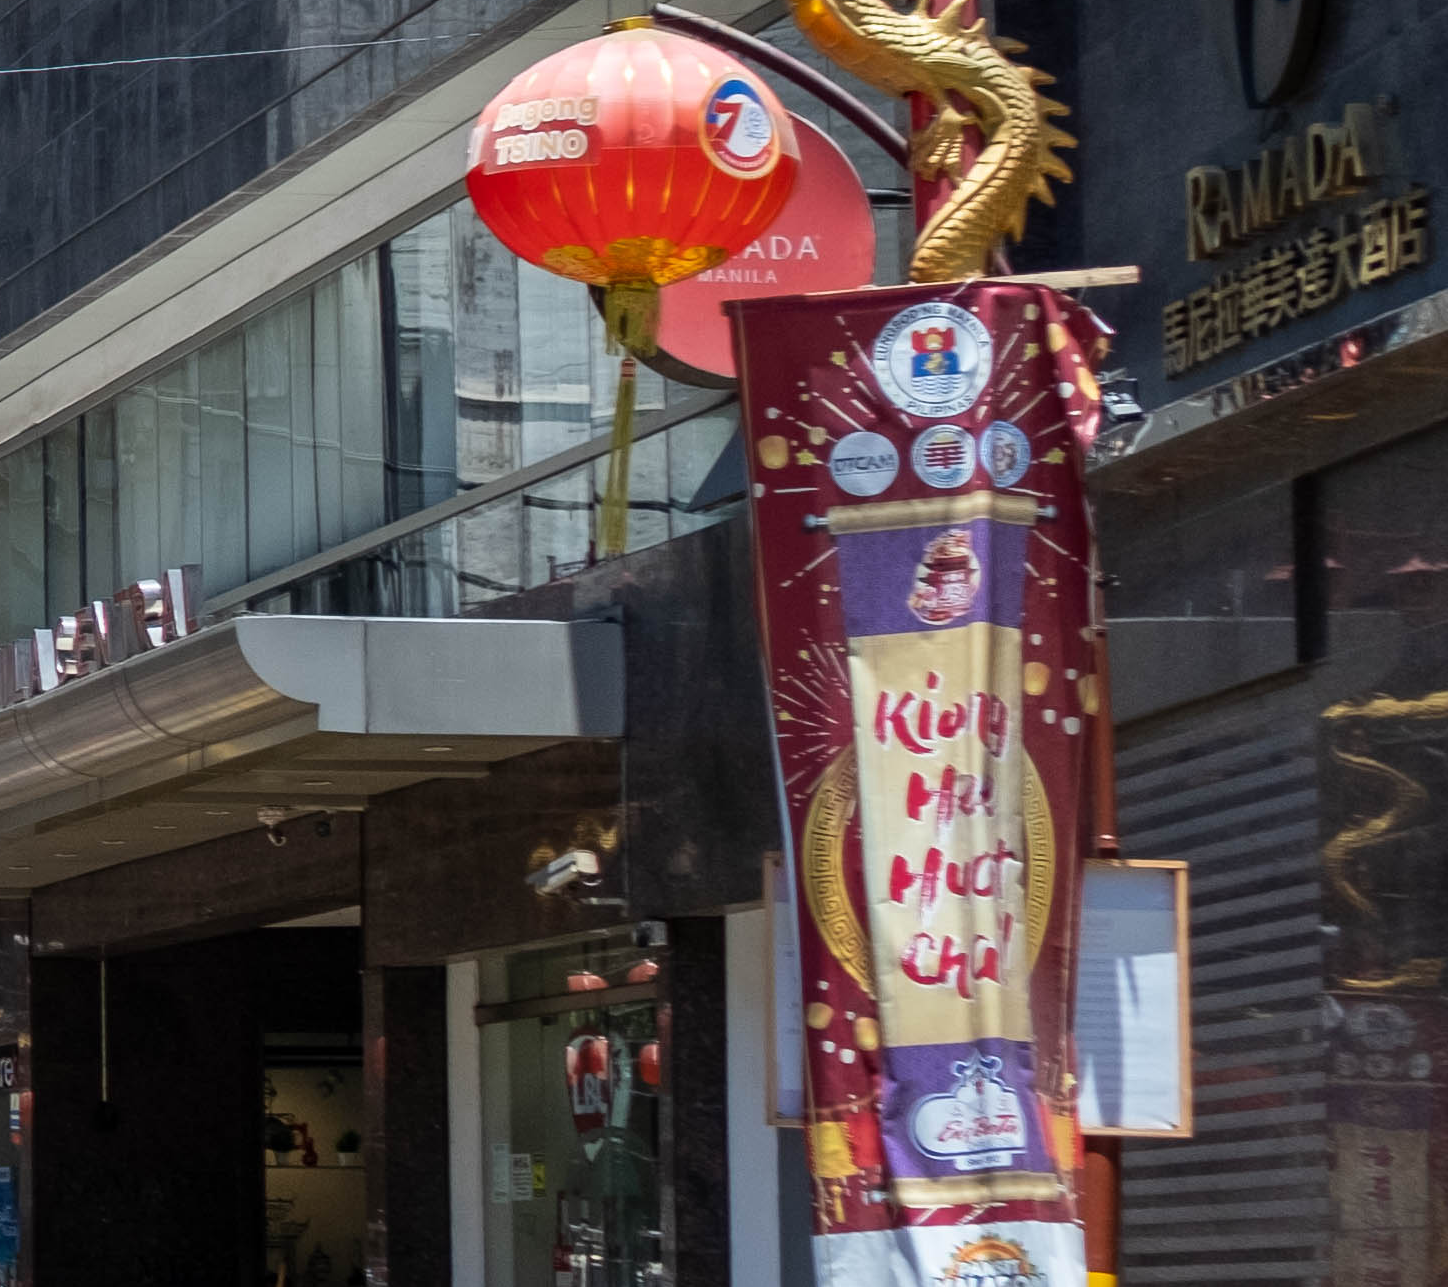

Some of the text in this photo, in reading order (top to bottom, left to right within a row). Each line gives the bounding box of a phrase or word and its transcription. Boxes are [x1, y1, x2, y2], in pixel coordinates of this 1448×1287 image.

[494, 129, 588, 165] TSINO
[1185, 102, 1372, 262] RAMADA
[742, 235, 820, 260] ADA
[697, 269, 778, 284] MANILA
[873, 671, 1009, 757] Kiong
